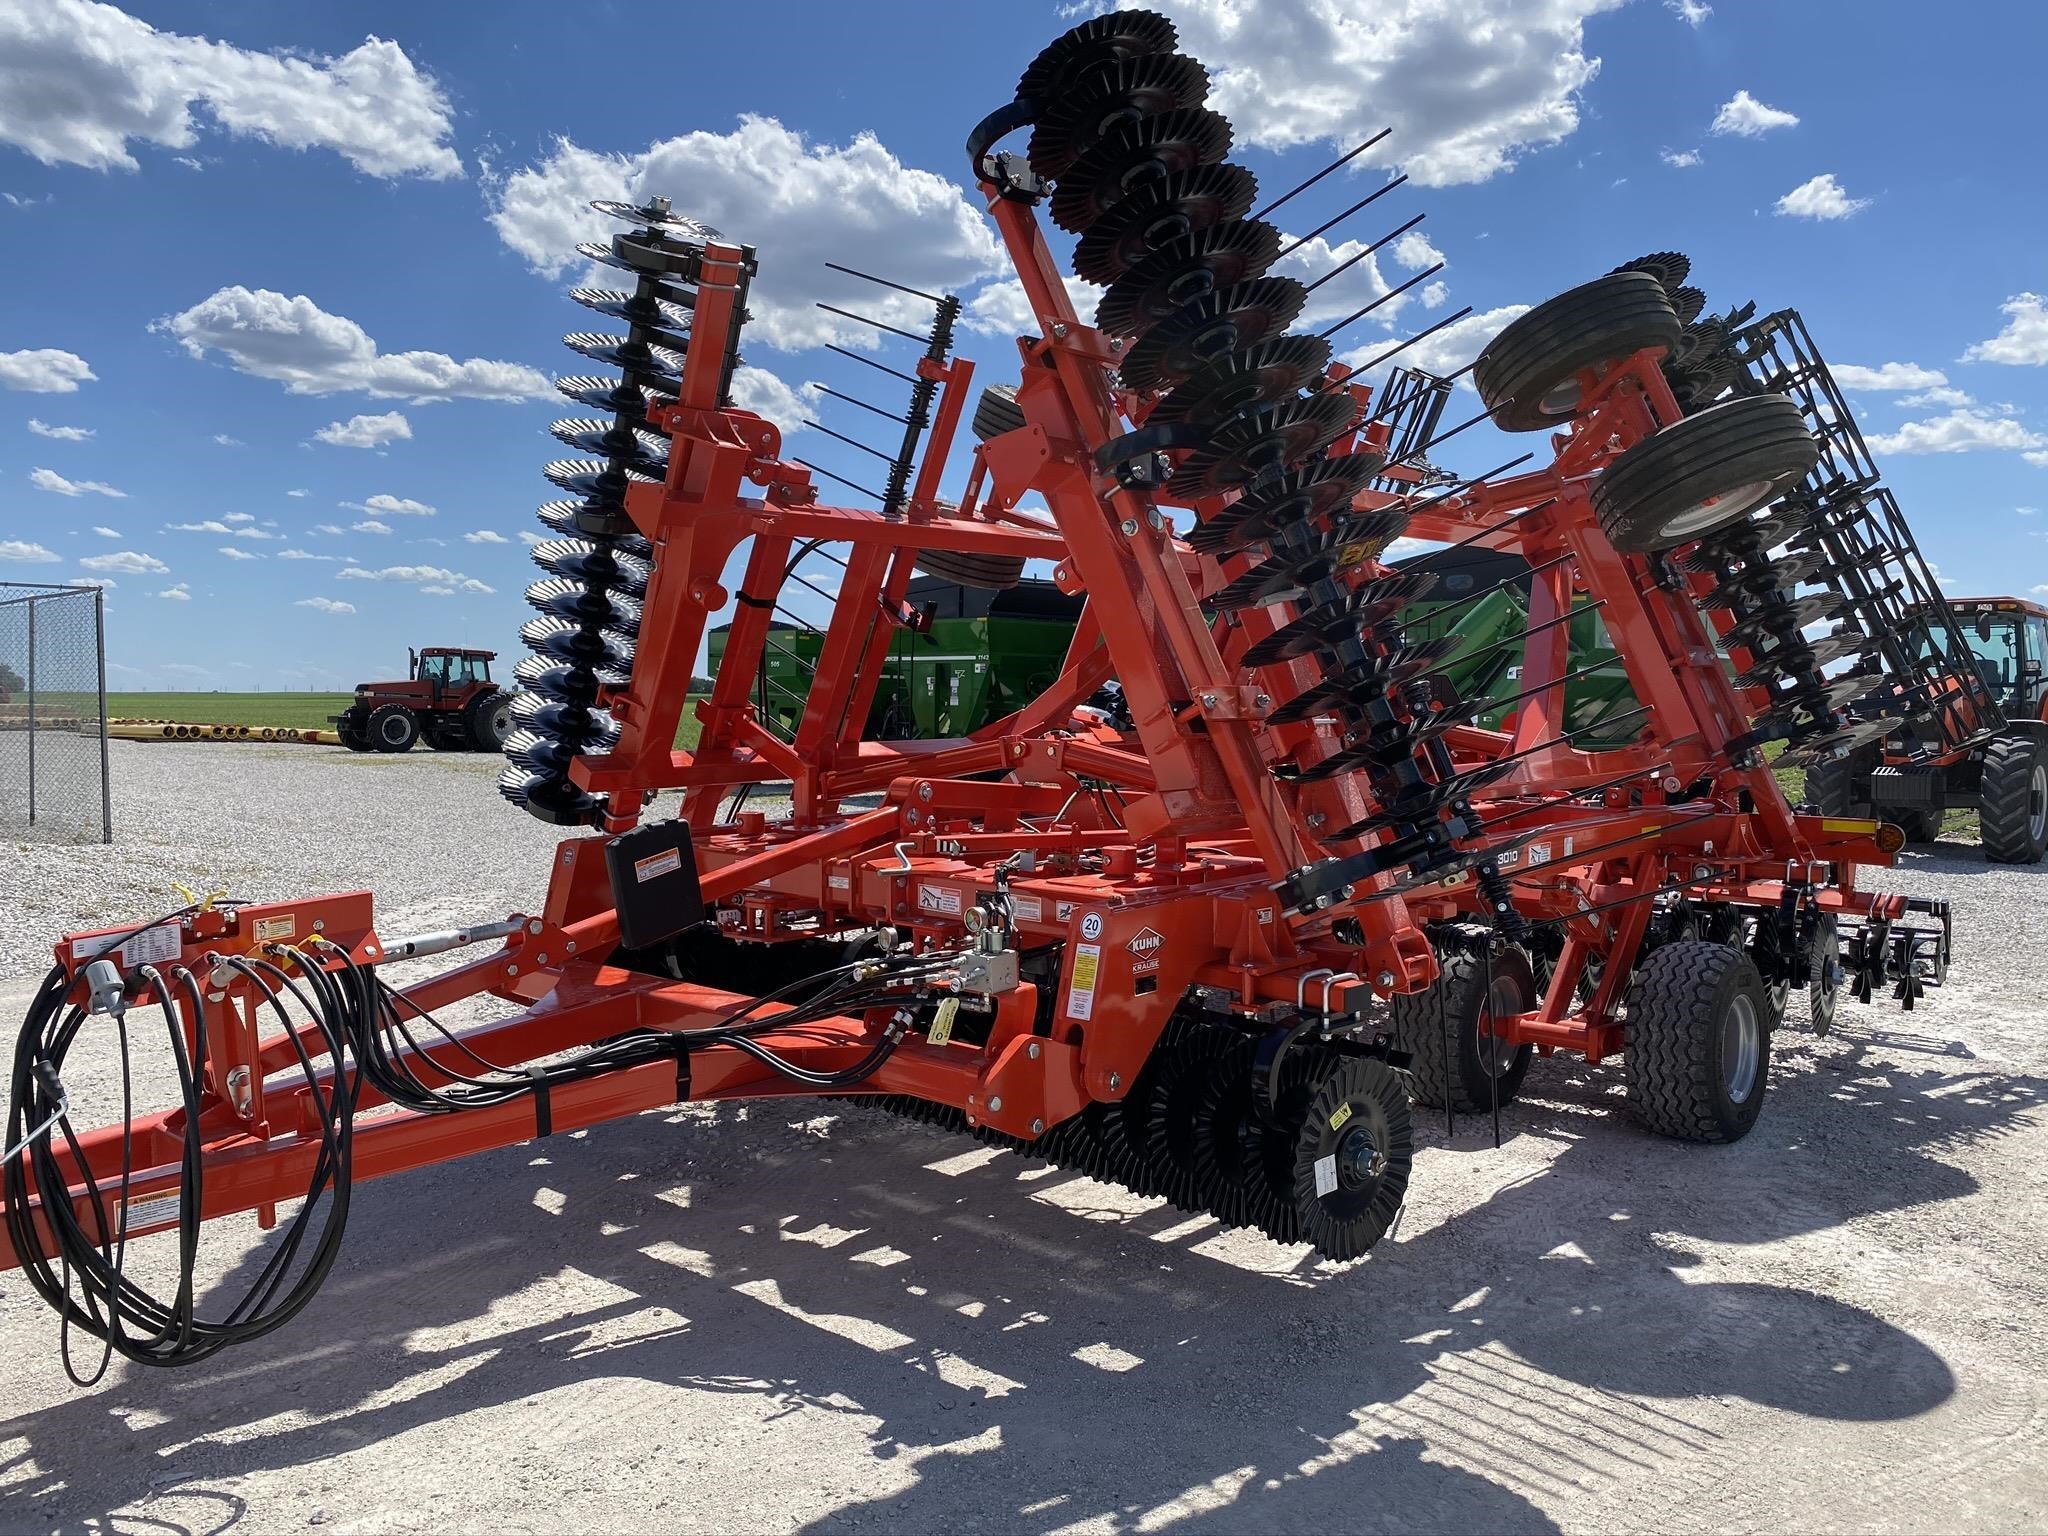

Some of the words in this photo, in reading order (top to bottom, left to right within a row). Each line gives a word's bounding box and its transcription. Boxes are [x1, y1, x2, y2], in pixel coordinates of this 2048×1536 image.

[1497, 850, 1518, 865] 3010
[1085, 918, 1099, 932] 20
[1132, 935, 1160, 952] KUHN
[1132, 959, 1160, 972] KRAUSE
